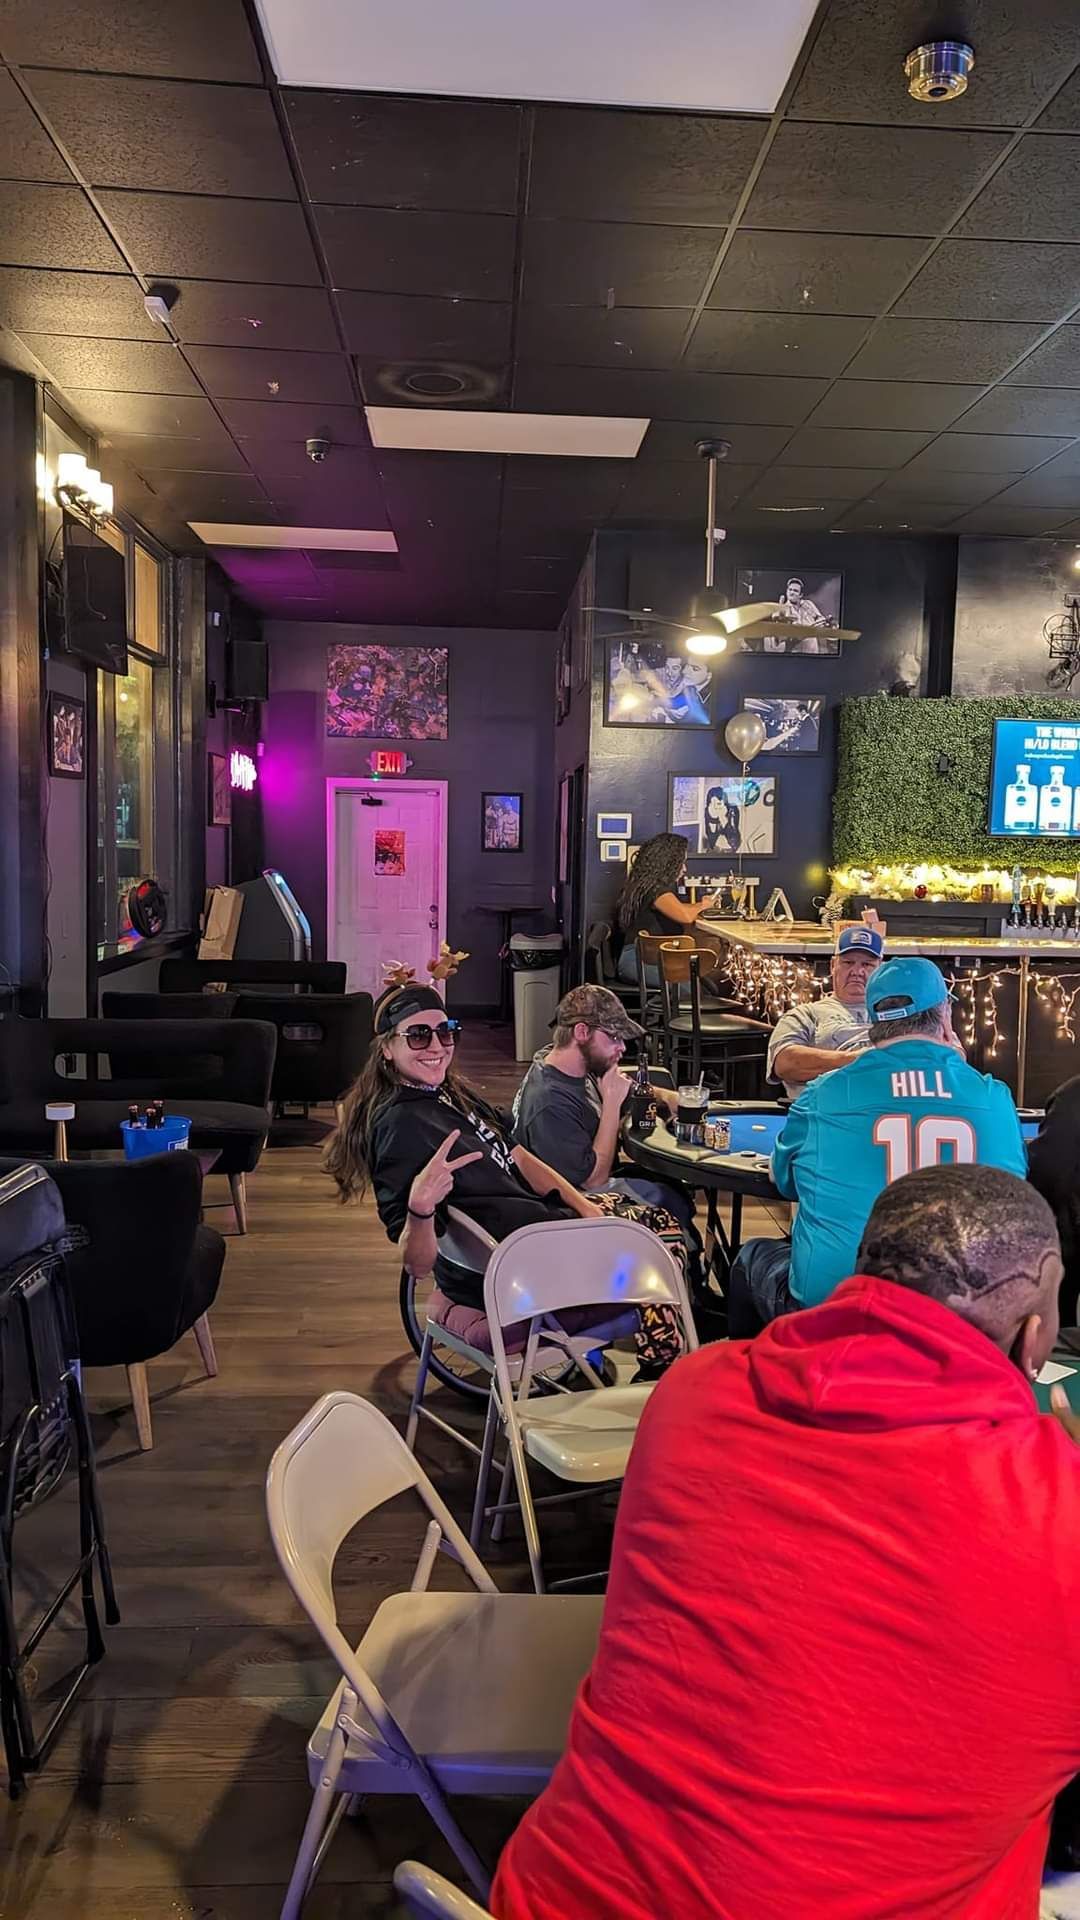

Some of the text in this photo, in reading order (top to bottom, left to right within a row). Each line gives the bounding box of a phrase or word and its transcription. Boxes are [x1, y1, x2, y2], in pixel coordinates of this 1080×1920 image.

[1036, 726, 1053, 737] THE
[1050, 739, 1078, 751] BLEND
[377, 751, 402, 773] EXIT
[891, 1070, 952, 1099] HILL
